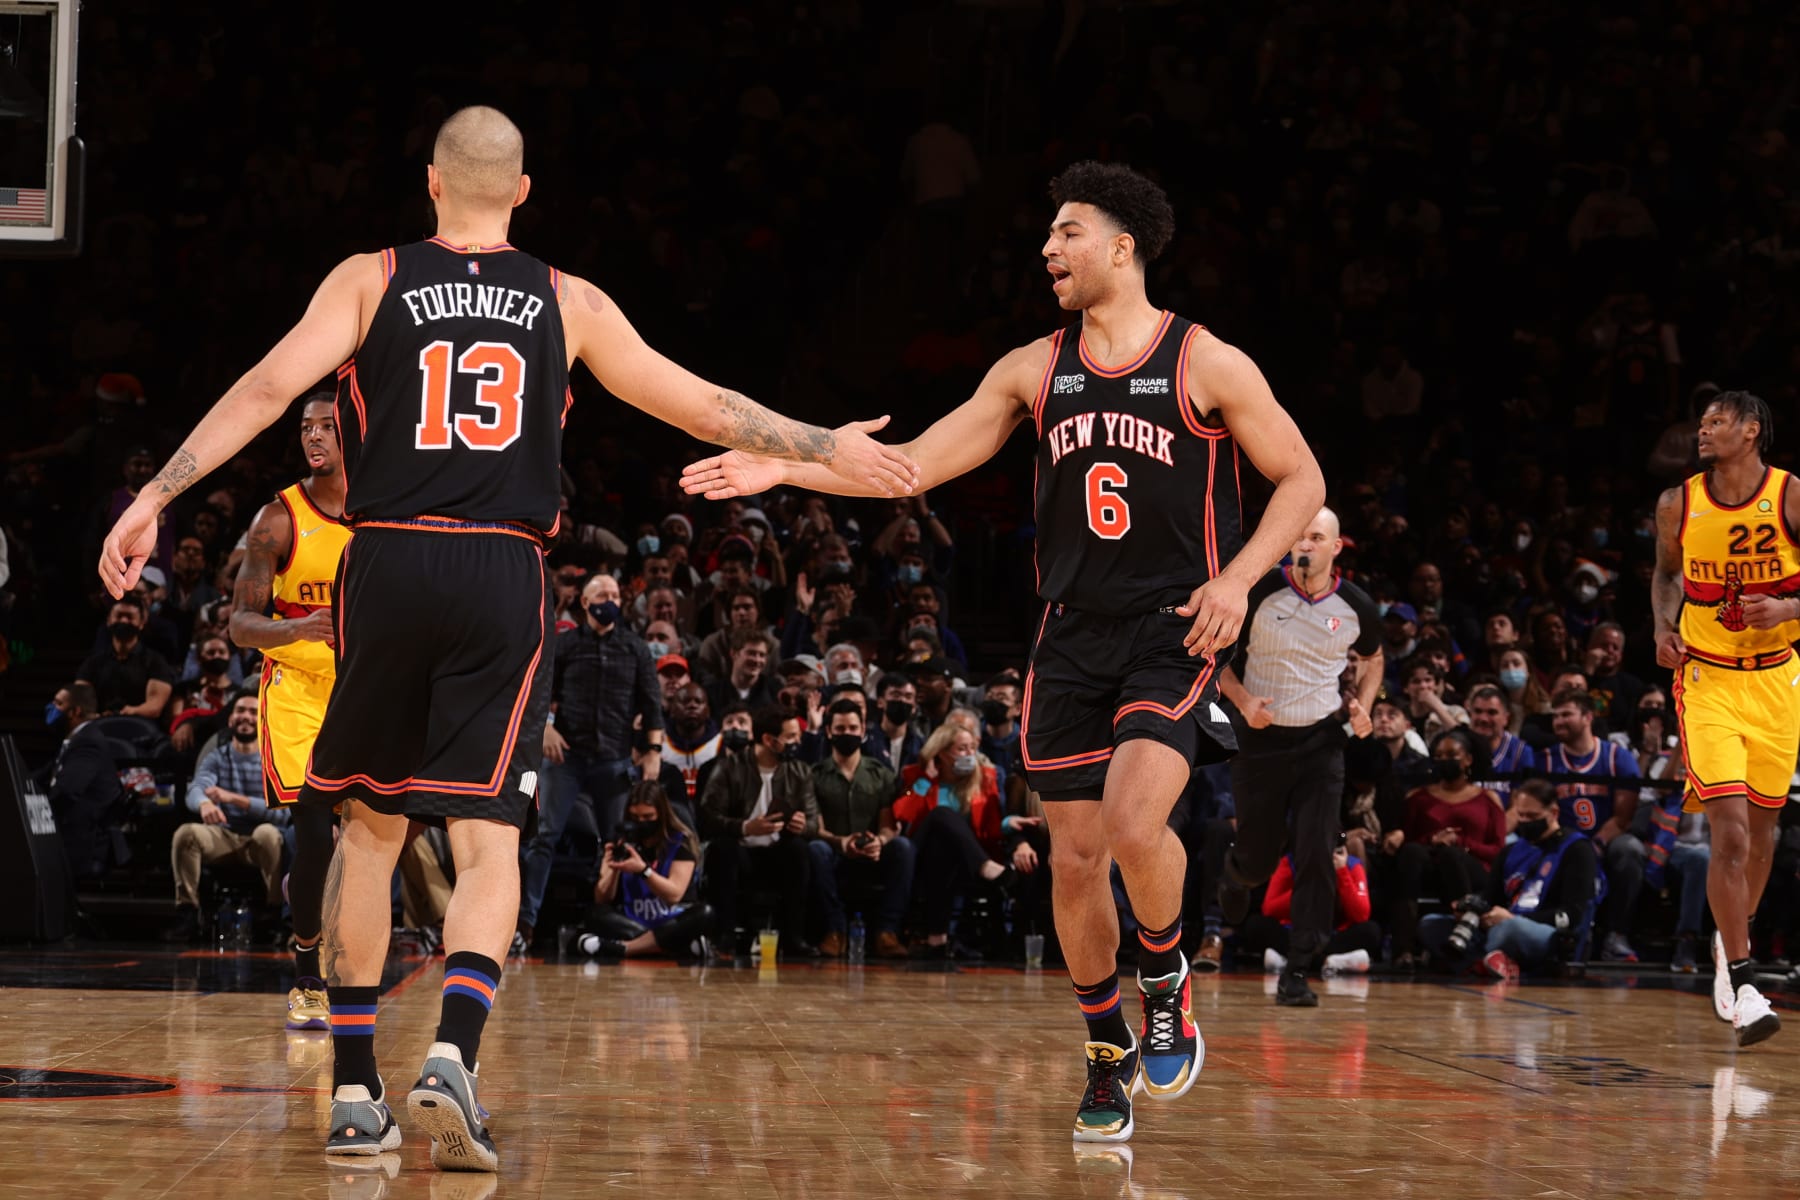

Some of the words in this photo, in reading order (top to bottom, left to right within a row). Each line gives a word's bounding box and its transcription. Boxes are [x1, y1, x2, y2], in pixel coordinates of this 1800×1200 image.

[402, 282, 544, 331] FOURNIER
[415, 340, 526, 451] 13
[1053, 374, 1086, 394] NYC
[1129, 386, 1160, 395] SPACE
[1130, 378, 1168, 387] SQUARE
[1048, 411, 1097, 468] NEW
[1101, 411, 1175, 468] YORK
[1085, 462, 1131, 540] 6
[1728, 523, 1778, 557] 22
[1689, 559, 1783, 580] ATLANTA
[1572, 797, 1597, 831] 9
